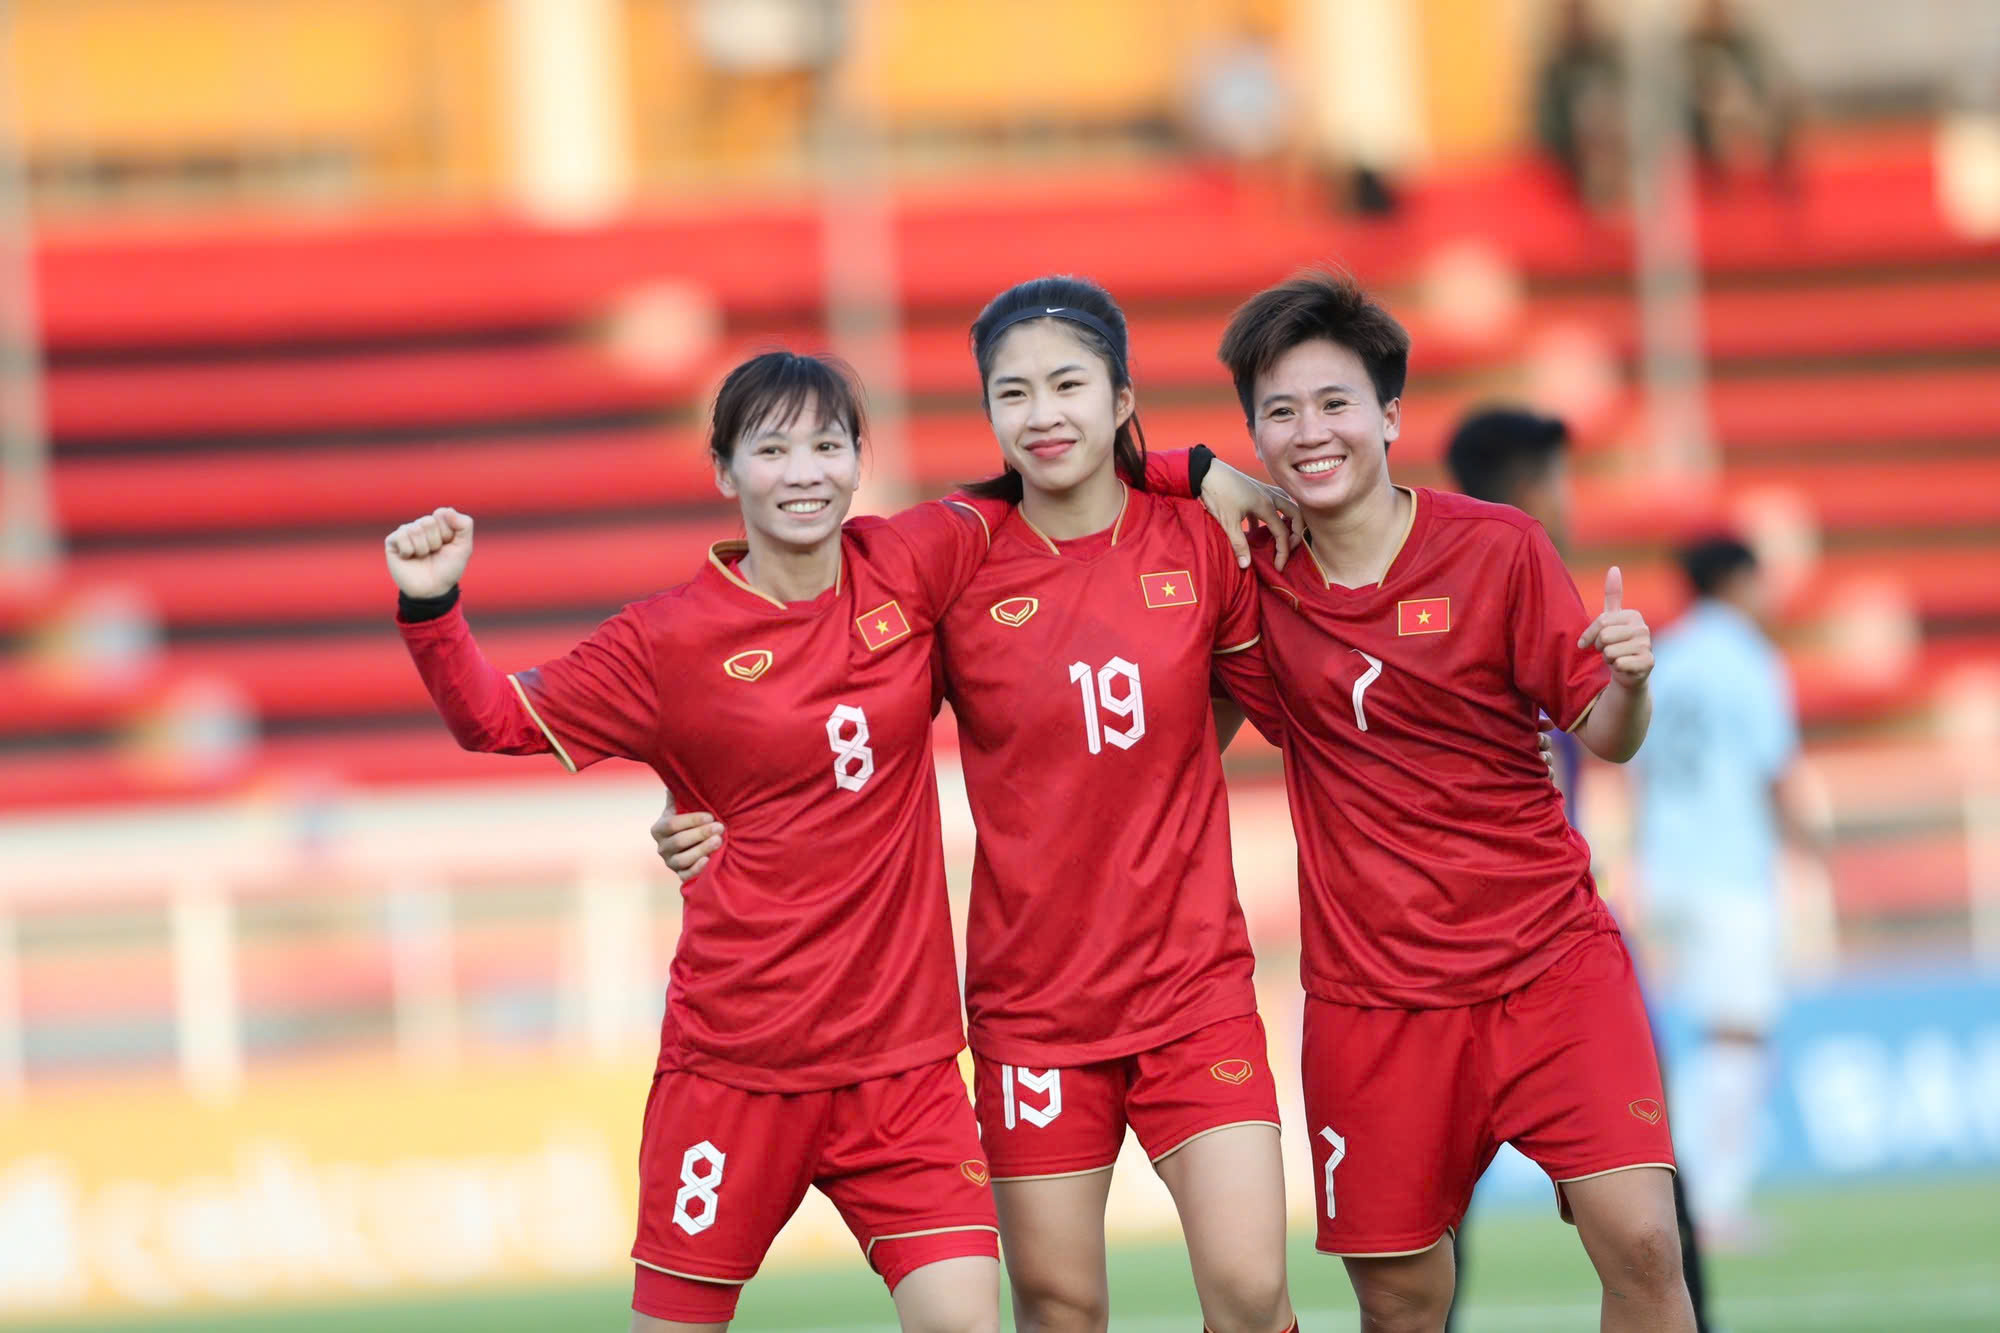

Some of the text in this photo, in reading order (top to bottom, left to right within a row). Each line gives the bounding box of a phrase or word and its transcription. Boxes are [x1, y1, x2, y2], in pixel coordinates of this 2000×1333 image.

[1068, 655, 1146, 755] 19
[1351, 649, 1383, 732] 7
[825, 703, 875, 793] 8
[1001, 1064, 1062, 1131] 19
[671, 1140, 727, 1236] 8
[1318, 1125, 1346, 1220] 7
